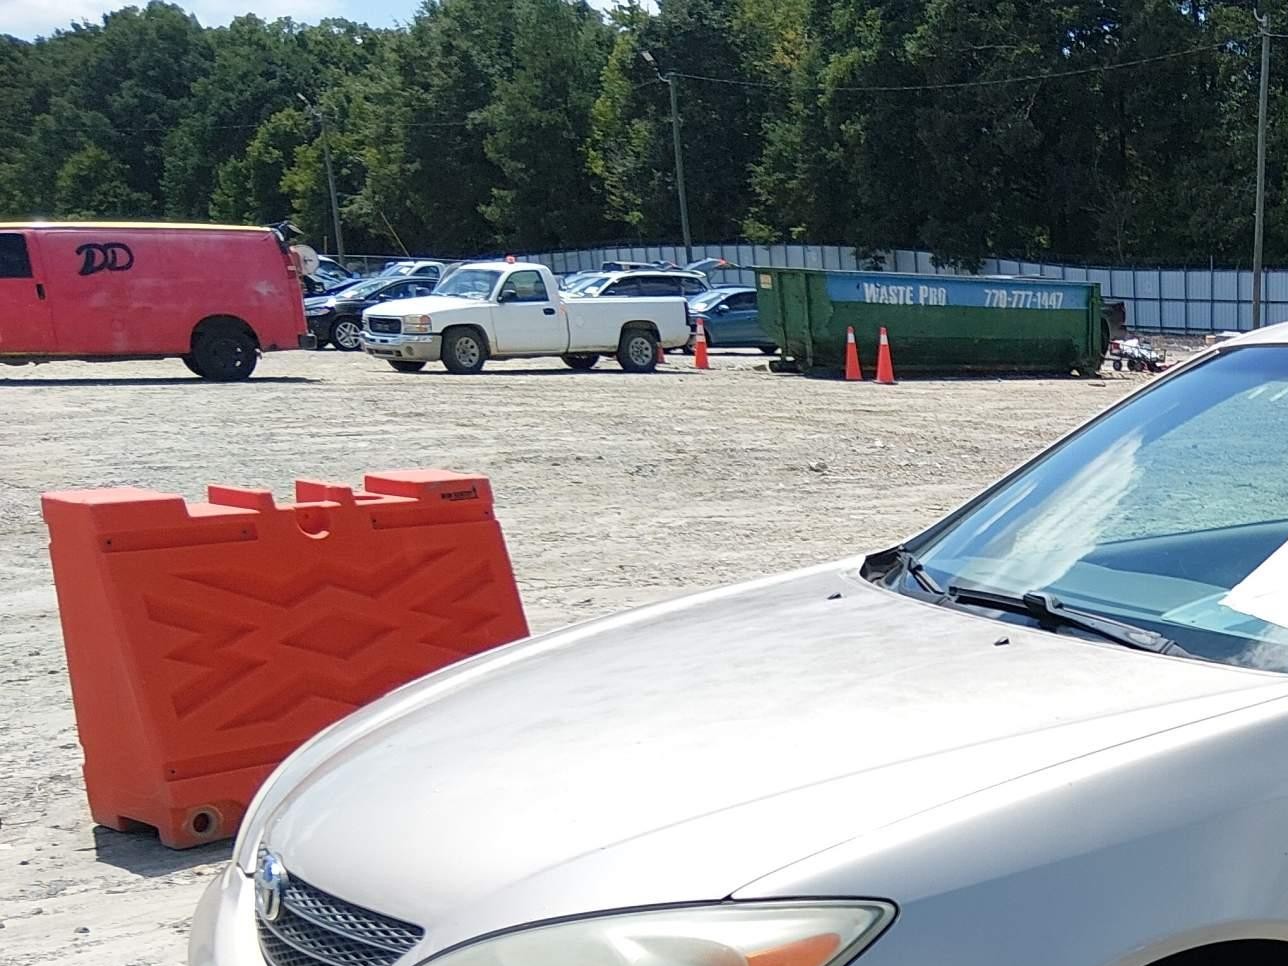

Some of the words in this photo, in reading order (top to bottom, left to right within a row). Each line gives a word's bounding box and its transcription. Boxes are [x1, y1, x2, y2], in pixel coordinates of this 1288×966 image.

[75, 242, 134, 276] DD
[863, 282, 914, 305] WASTE
[919, 285, 946, 307] PRO
[984, 289, 1064, 309] 770-777-1447
